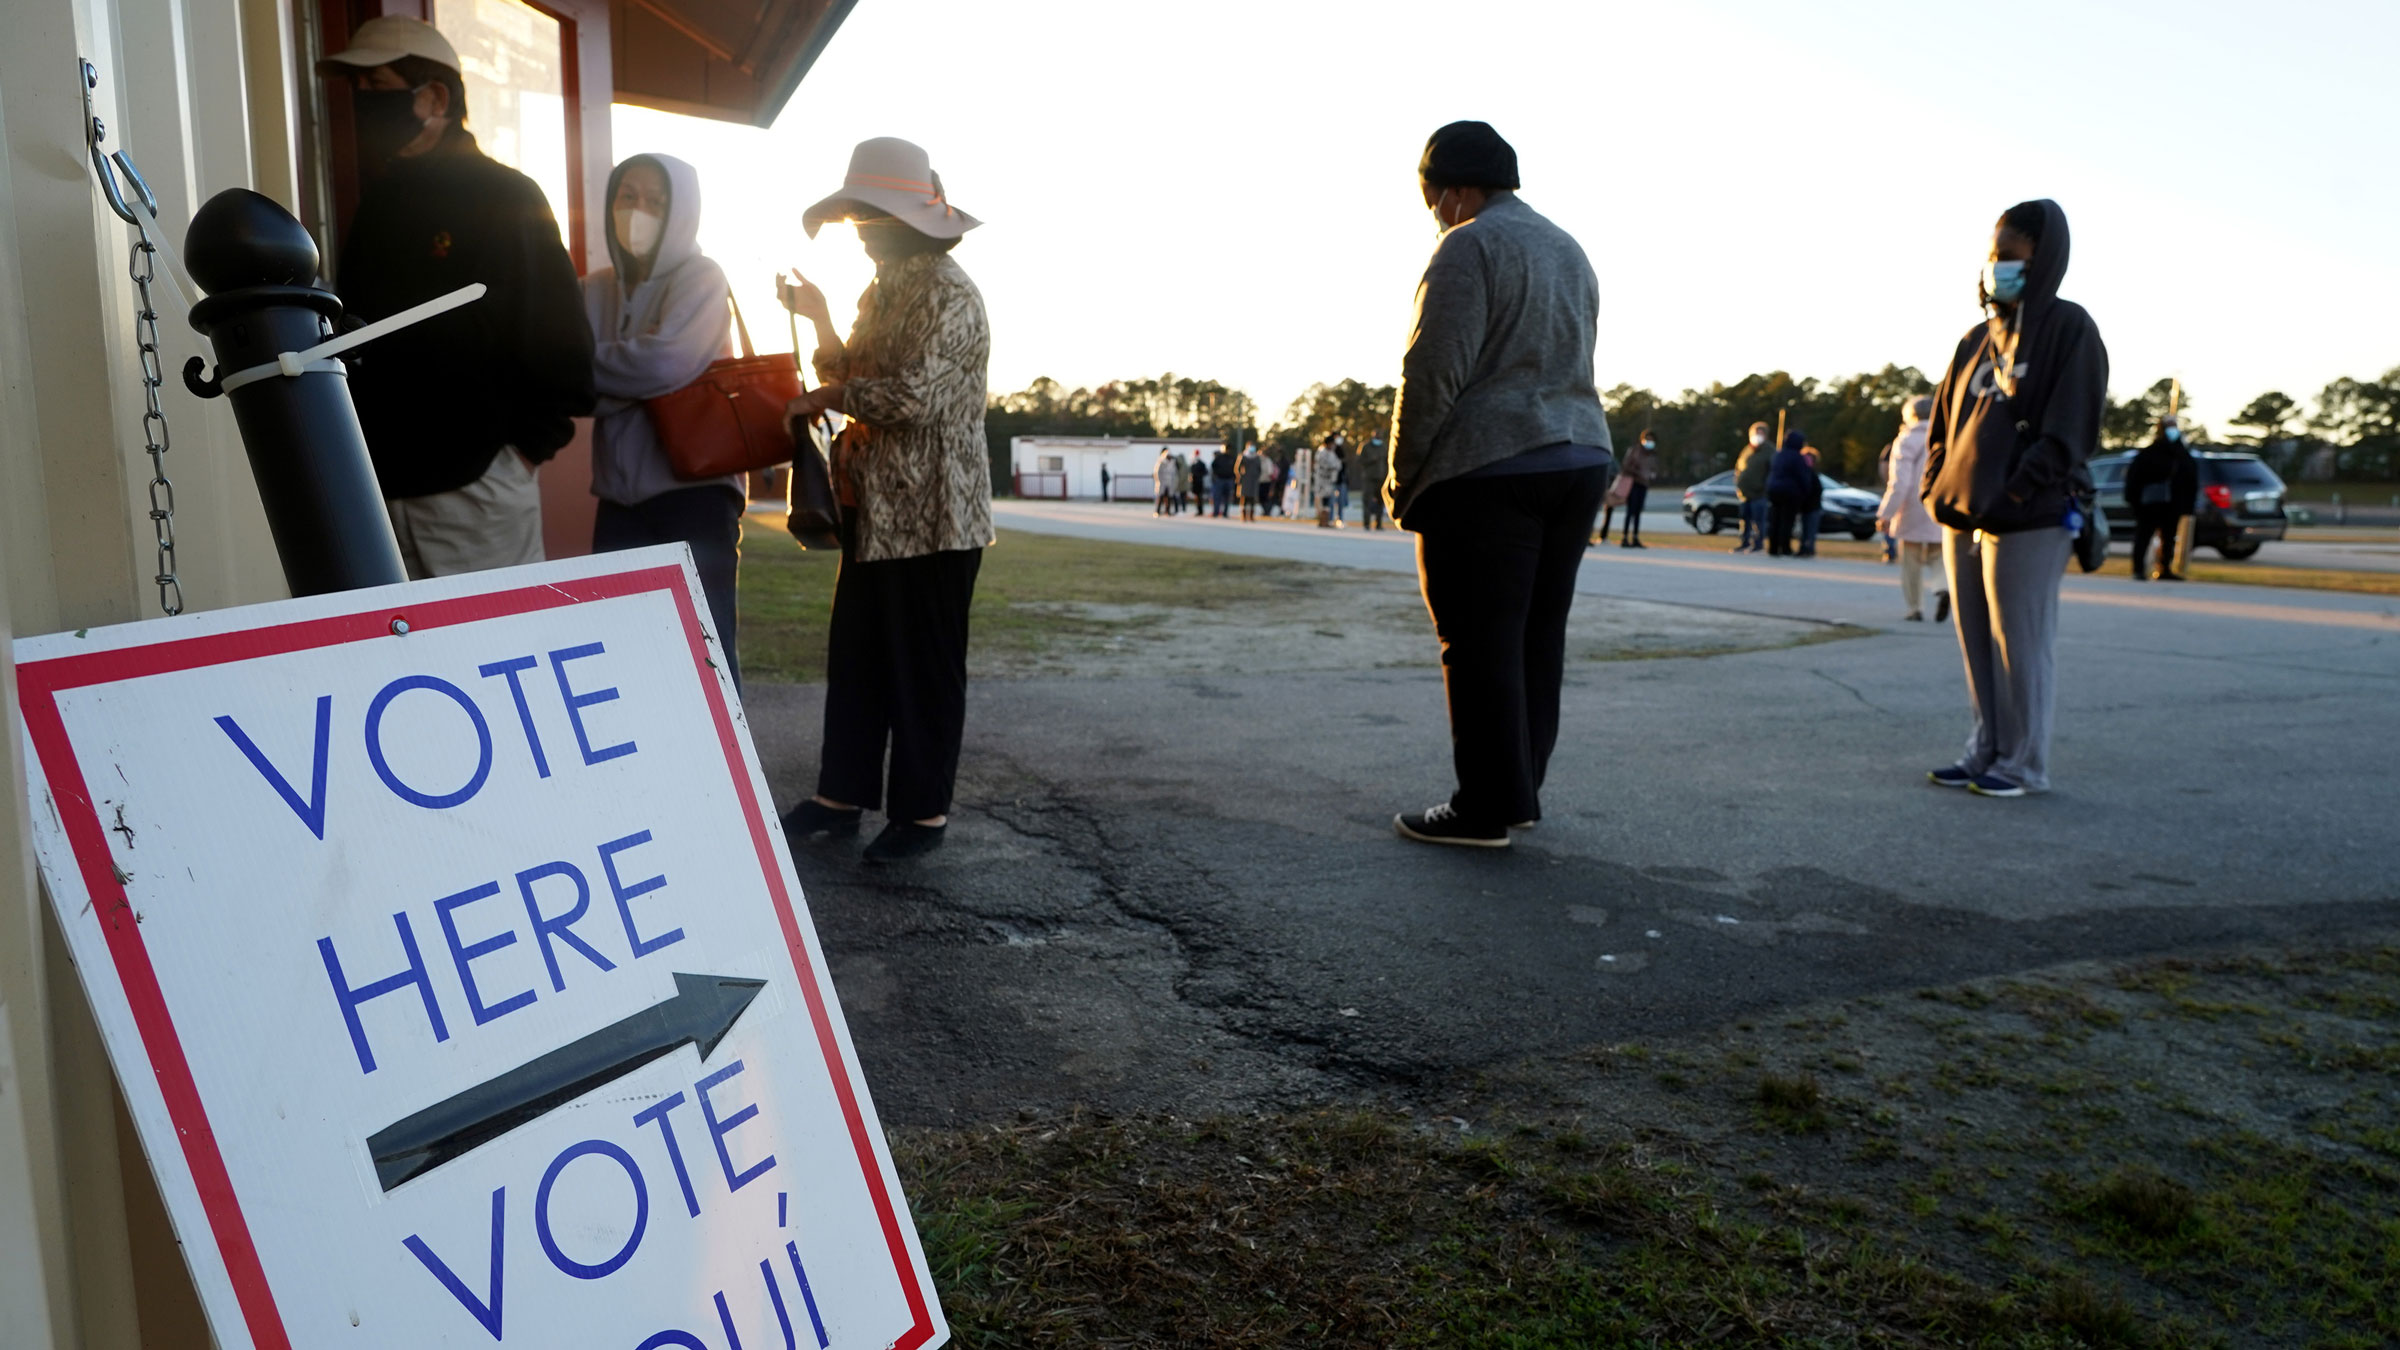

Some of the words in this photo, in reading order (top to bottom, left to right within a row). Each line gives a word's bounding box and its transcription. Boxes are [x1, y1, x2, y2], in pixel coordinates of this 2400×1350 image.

[212, 641, 638, 841] VOTE
[316, 828, 687, 1075] HERE
[402, 1059, 777, 1342] VOTE
